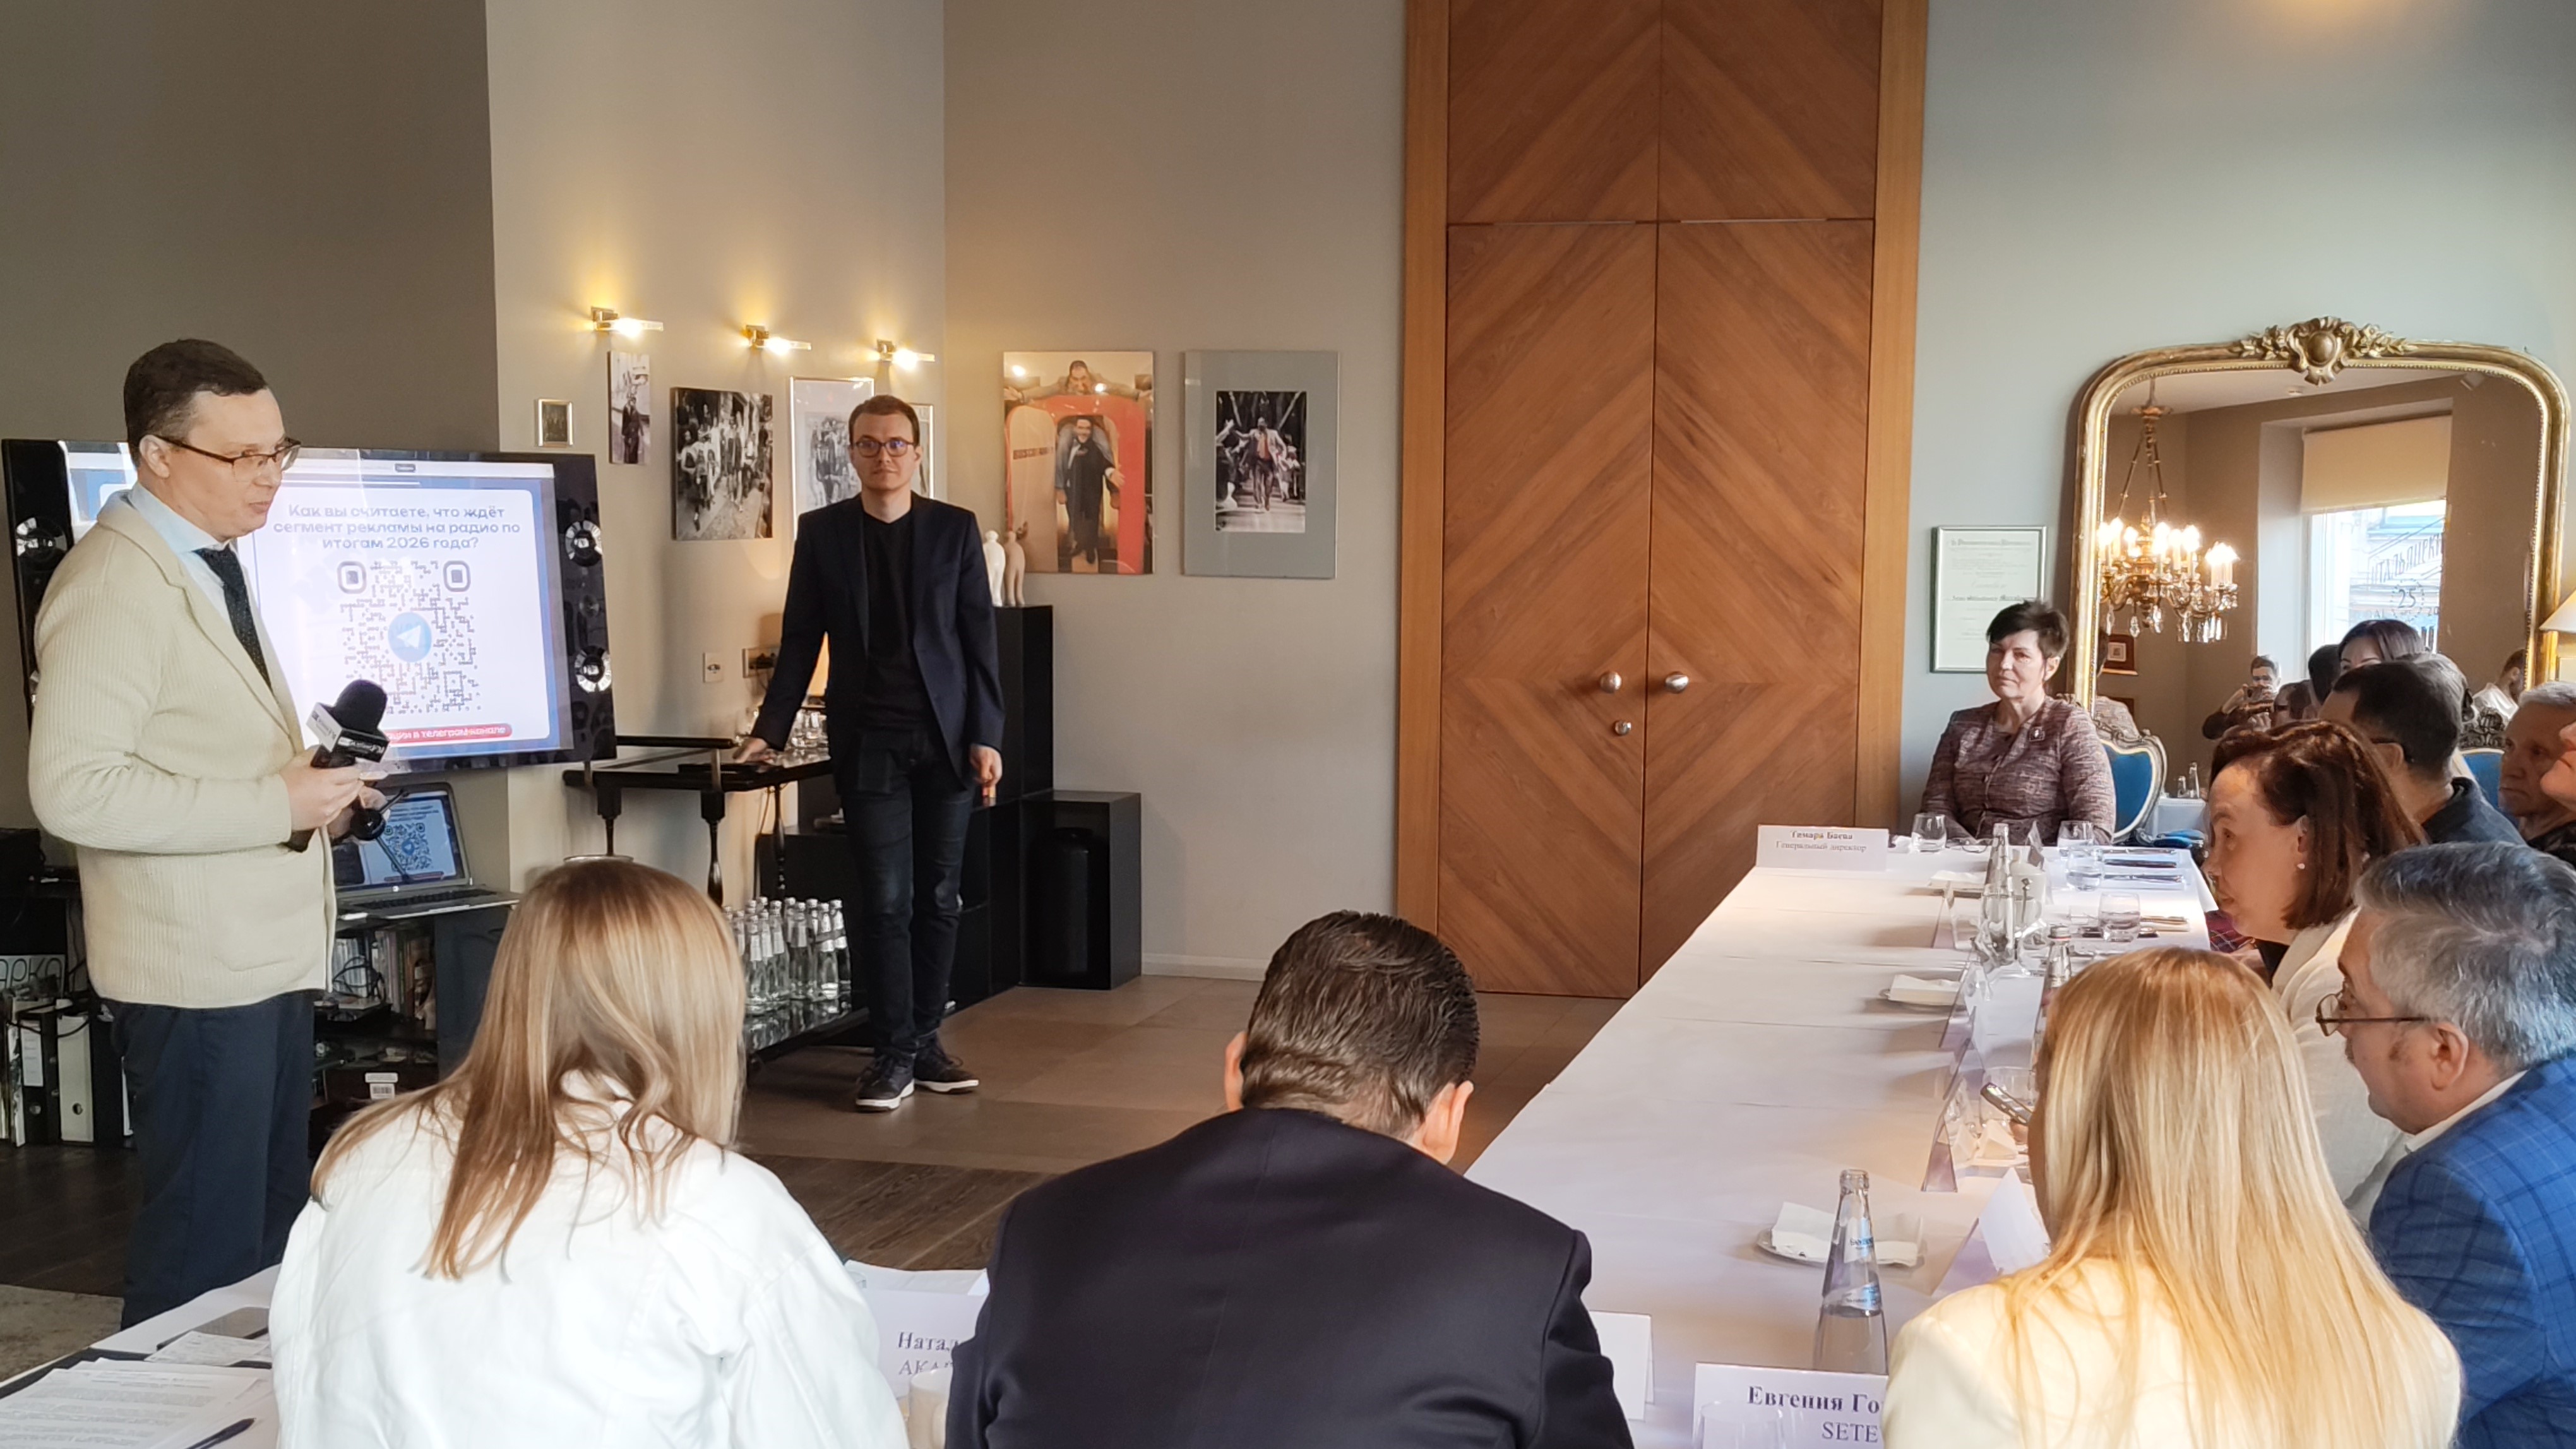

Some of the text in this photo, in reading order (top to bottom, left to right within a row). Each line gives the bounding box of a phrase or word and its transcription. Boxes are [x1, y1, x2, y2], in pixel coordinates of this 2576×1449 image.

[289, 504, 504, 519] Как вы считаете, что ждёт
[273, 523, 521, 535] сегмент рекламы на радио по
[323, 537, 479, 549] итогам 2026 года?
[1748, 1386, 1883, 1414] Евгения Го
